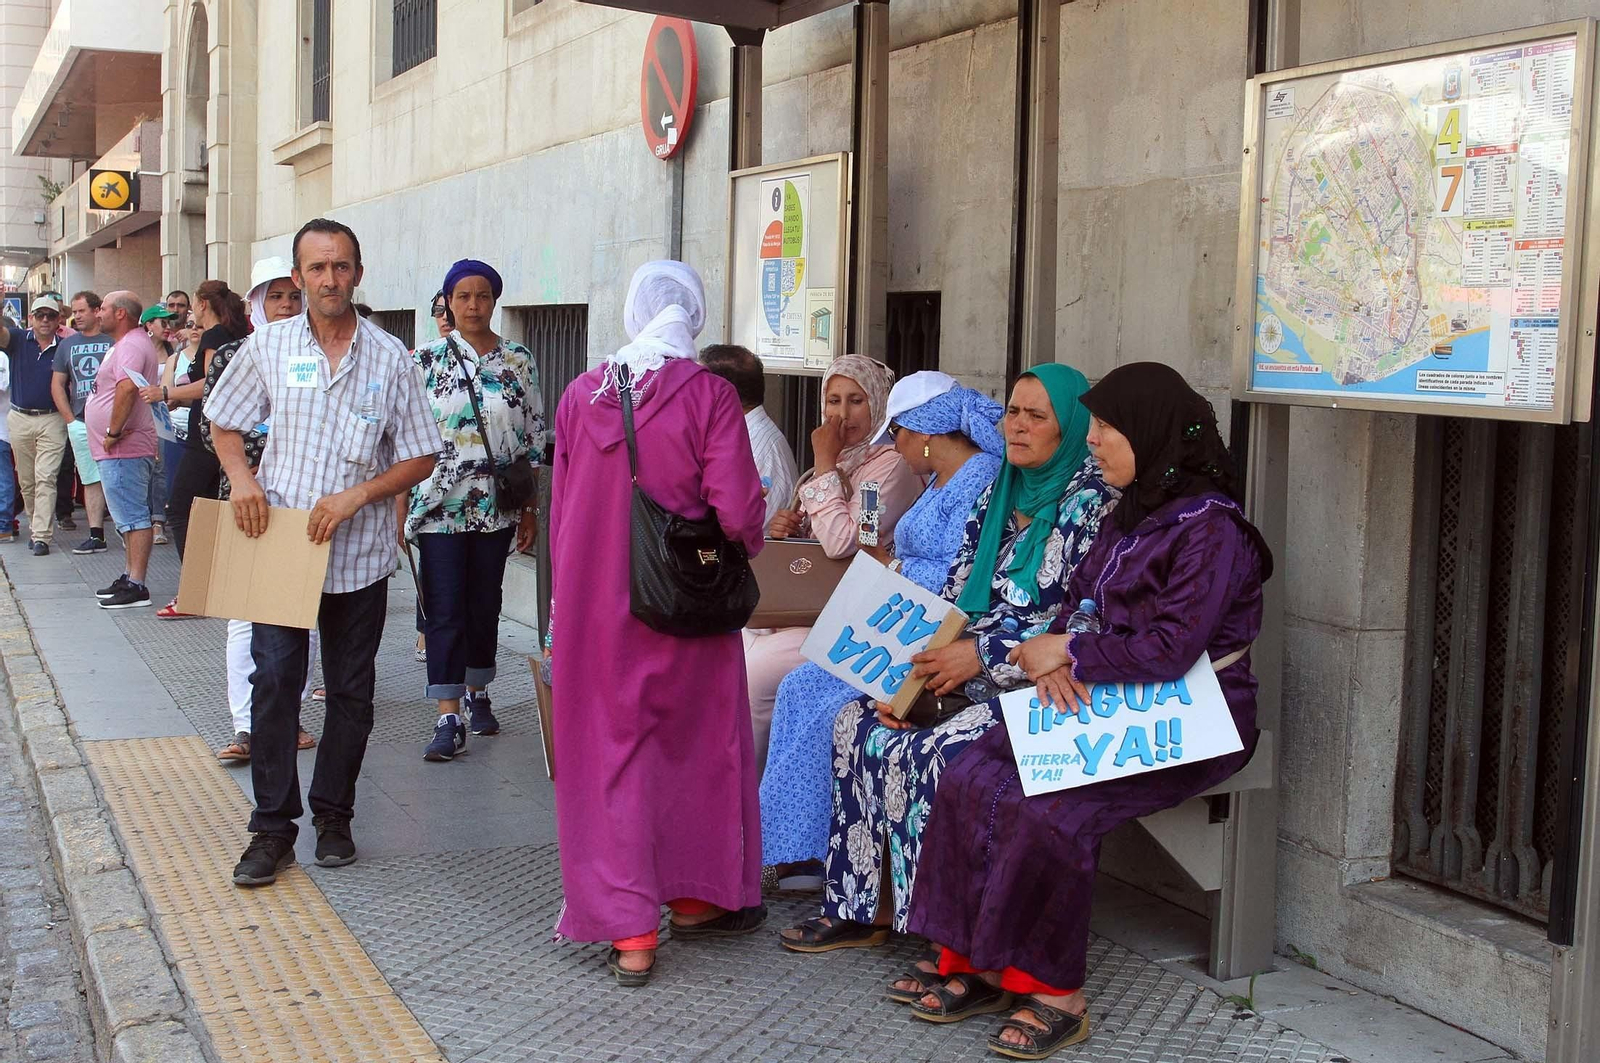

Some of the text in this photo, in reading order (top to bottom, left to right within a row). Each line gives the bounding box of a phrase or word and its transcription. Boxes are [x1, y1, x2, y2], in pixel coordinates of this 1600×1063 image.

[1438, 108, 1462, 154] 4
[1441, 166, 1463, 212] 7
[1514, 319, 1518, 327] 8
[72, 343, 108, 354] MADE
[82, 358, 95, 375] 4
[289, 362, 317, 373] ¡¡AGUA
[297, 373, 313, 382] YA!!
[866, 592, 942, 646] A!!
[827, 625, 914, 695] GUA
[1028, 676, 1192, 734] ¡¡AGUA
[1073, 717, 1183, 776] YA!!
[1020, 753, 1081, 767] ¡¡TIERRA
[1031, 768, 1064, 782] YA!!
